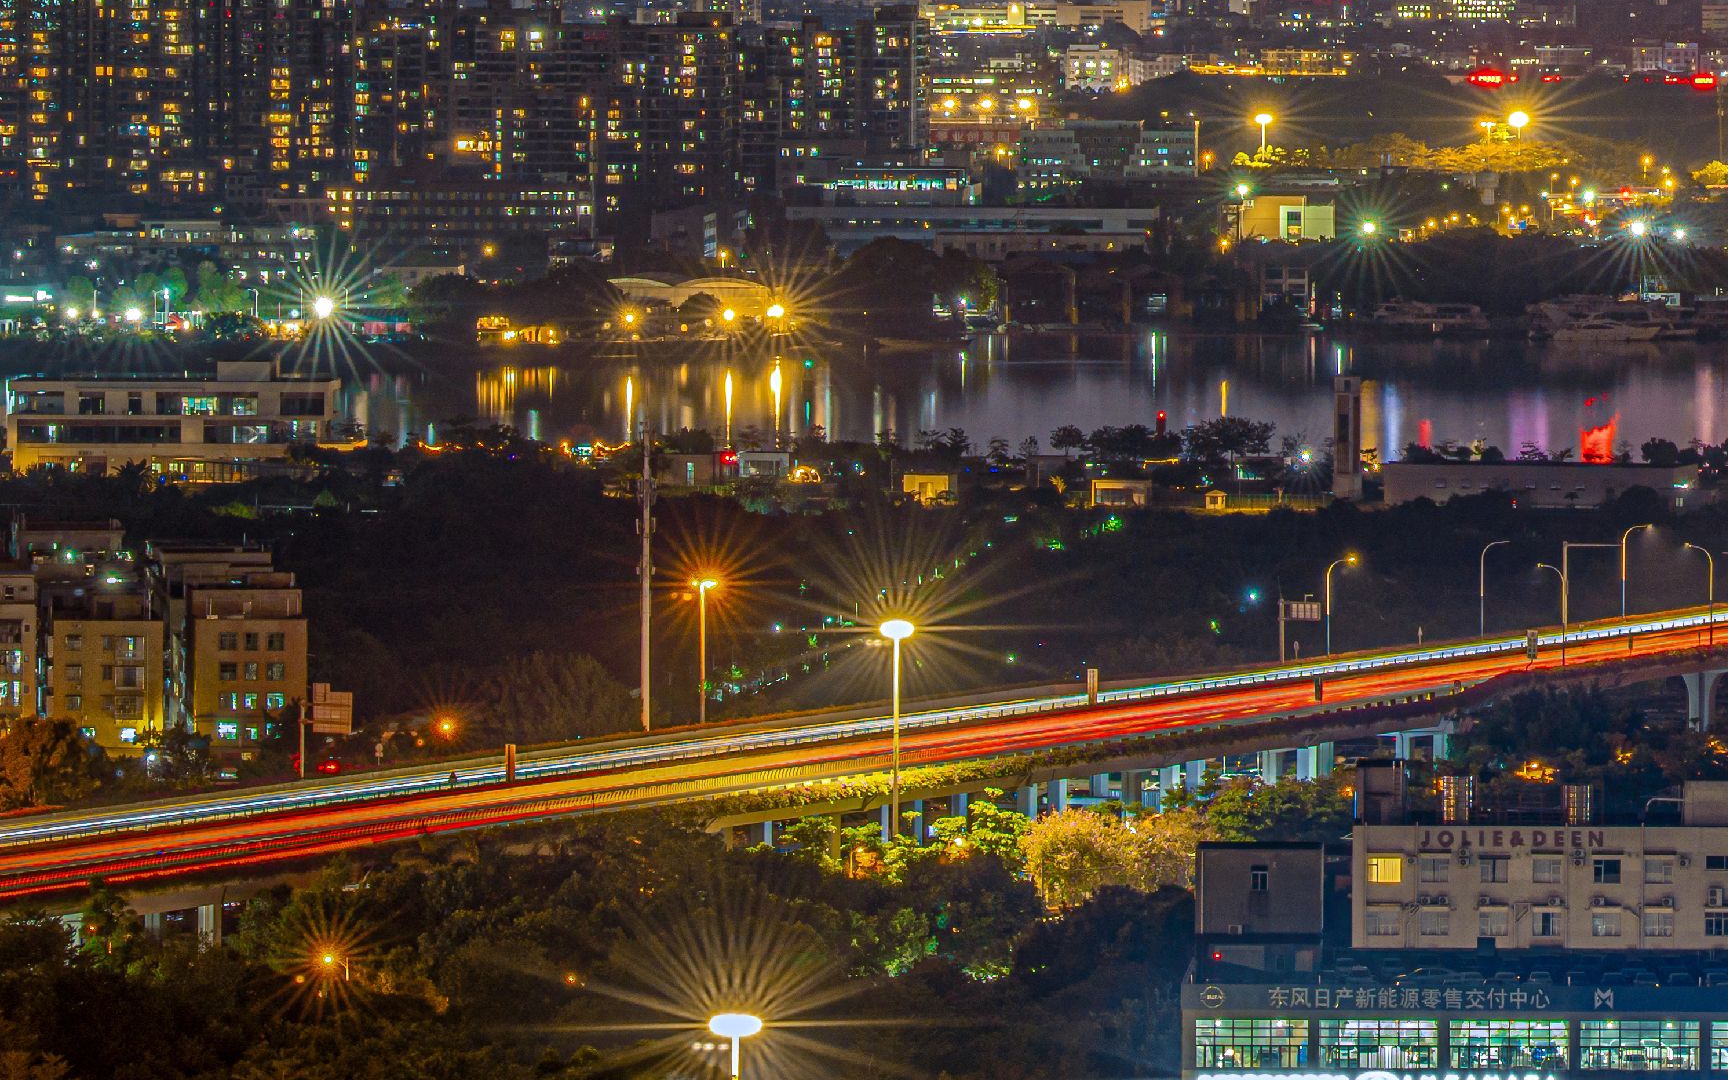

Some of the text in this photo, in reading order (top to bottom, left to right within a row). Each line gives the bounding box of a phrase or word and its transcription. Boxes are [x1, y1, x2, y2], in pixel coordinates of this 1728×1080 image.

[1420, 830, 1604, 848] JOLIE&DEEN
[1268, 986, 1551, 1010] 东风日产新能源零售交付中心
